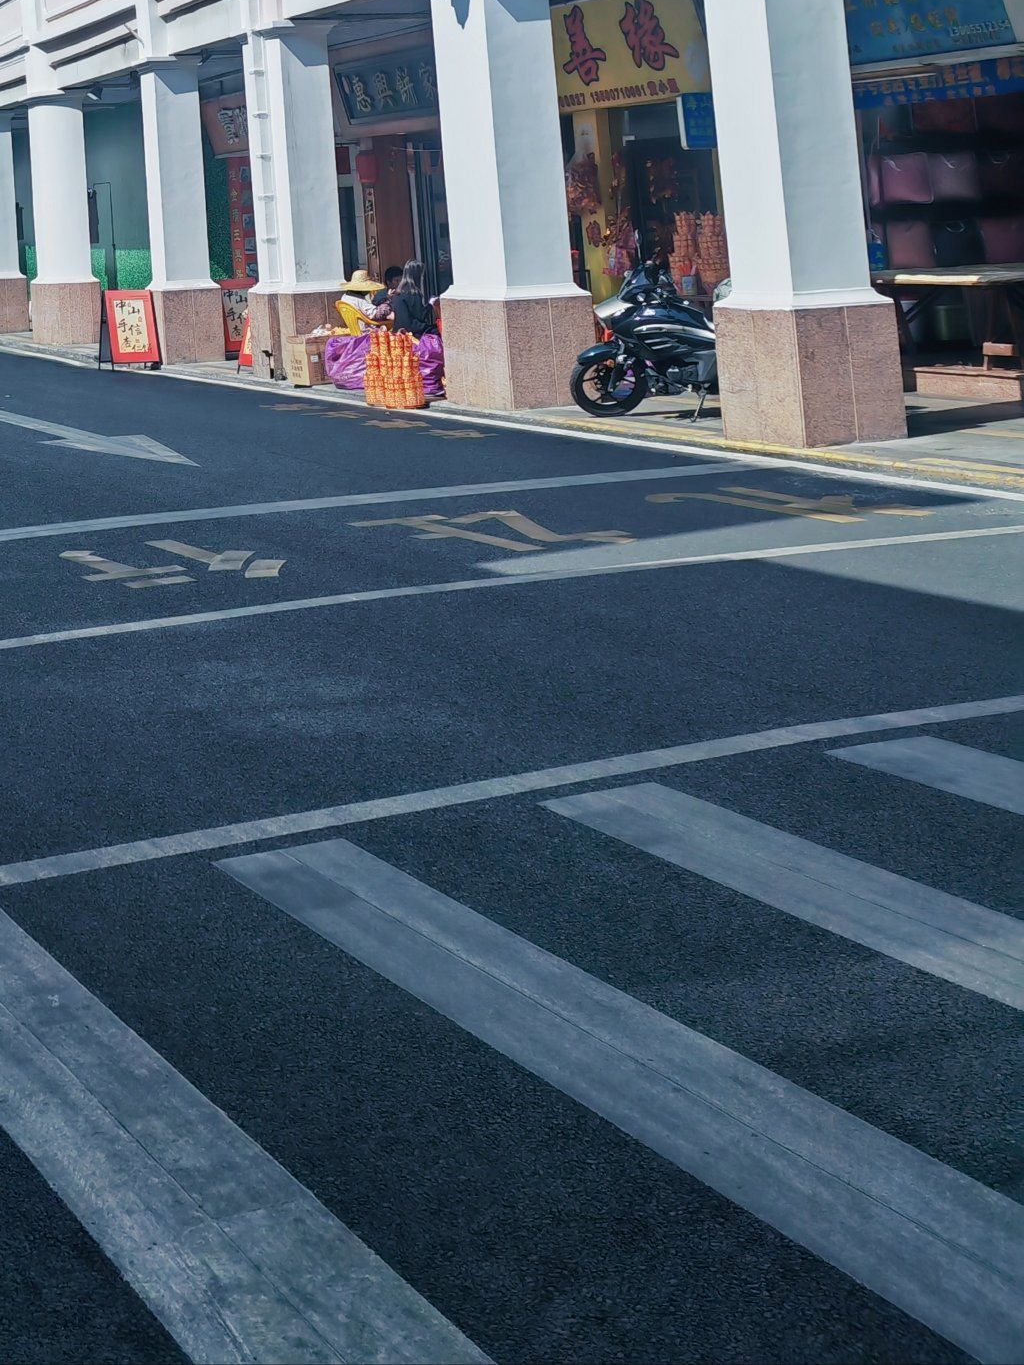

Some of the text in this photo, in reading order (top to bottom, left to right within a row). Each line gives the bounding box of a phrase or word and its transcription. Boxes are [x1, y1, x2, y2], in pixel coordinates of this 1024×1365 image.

[223, 290, 248, 304] 中山
[115, 299, 140, 315] 中山
[118, 318, 142, 336] 手信
